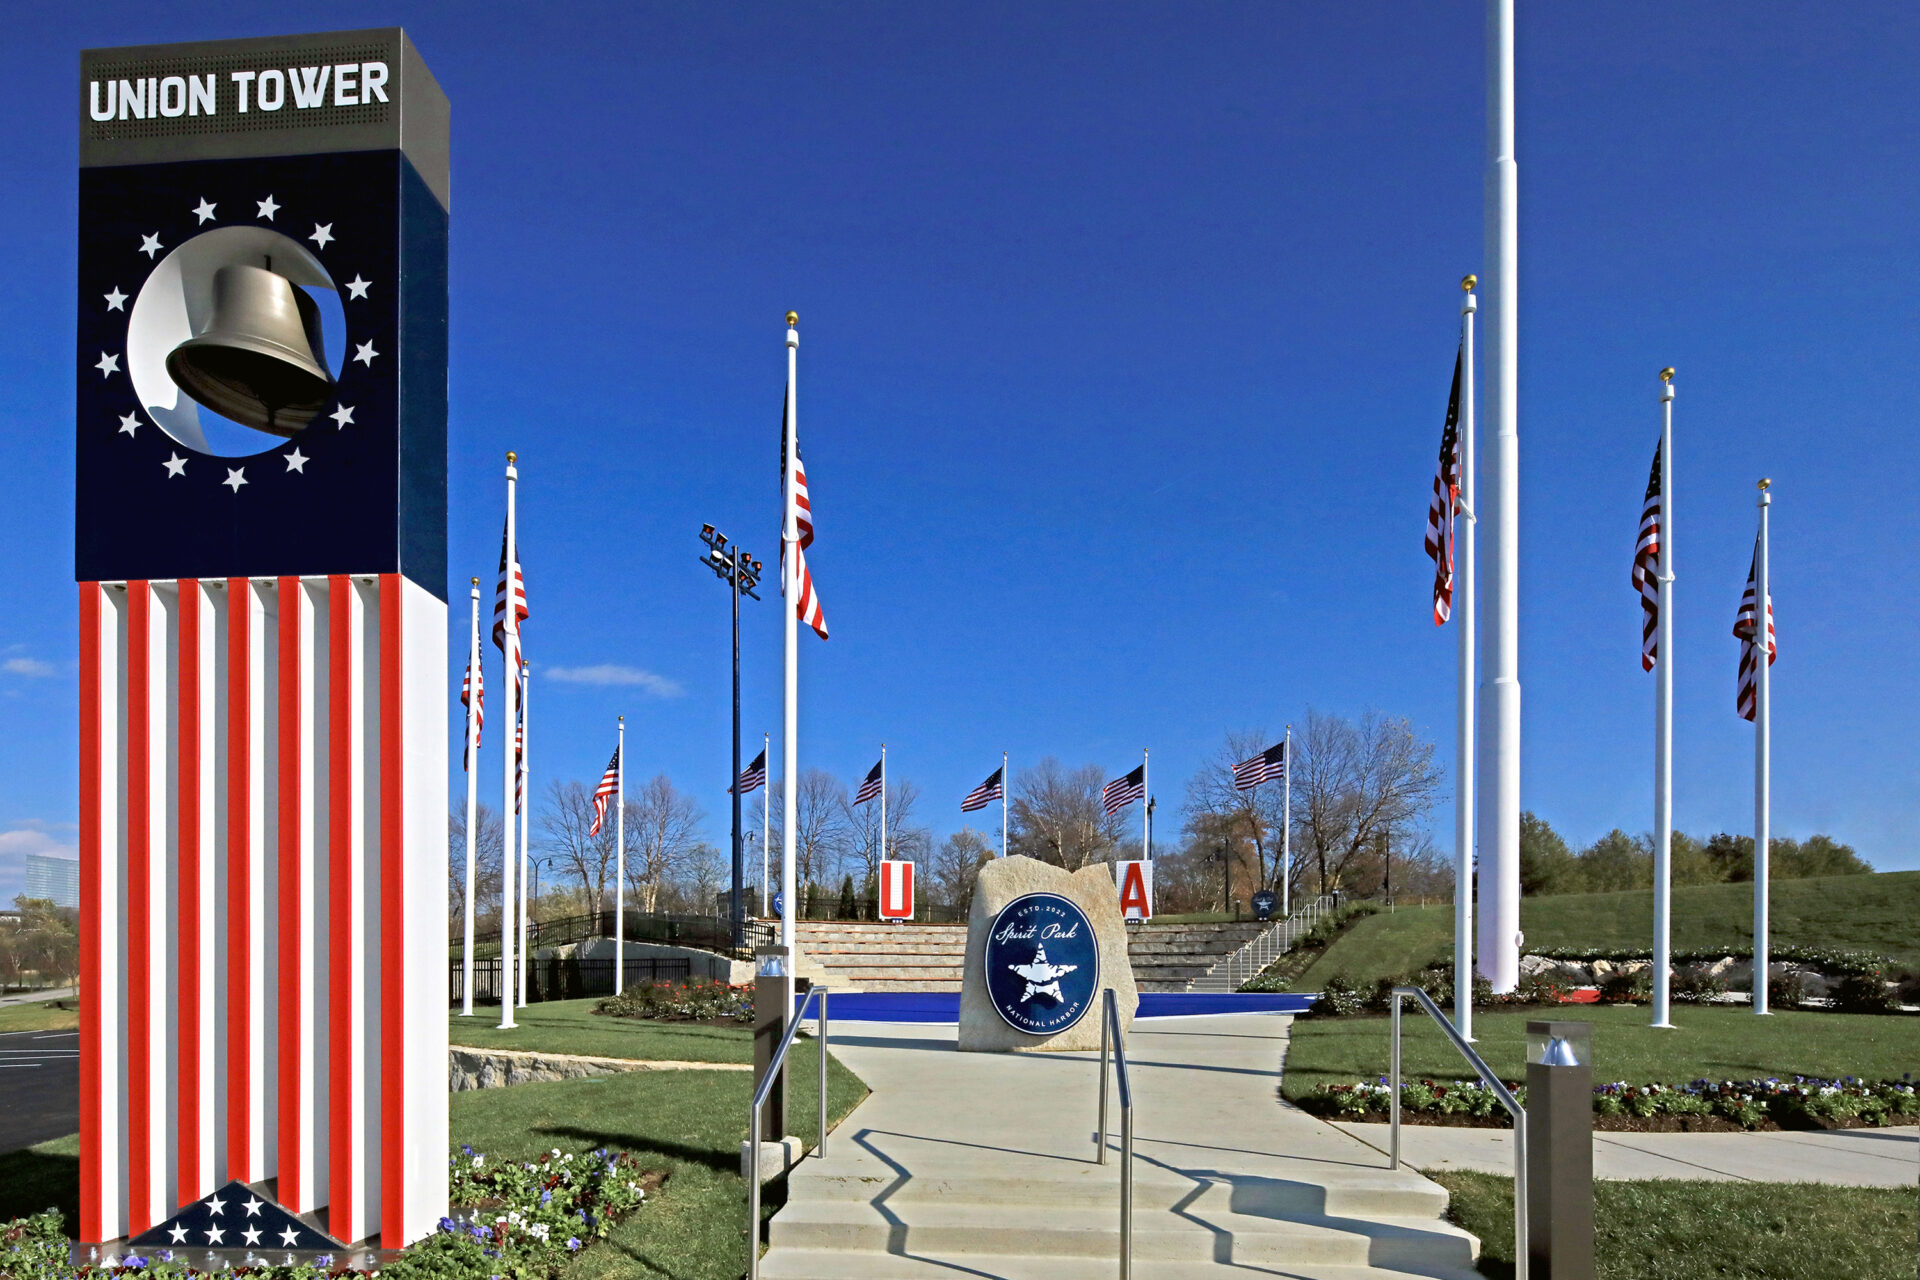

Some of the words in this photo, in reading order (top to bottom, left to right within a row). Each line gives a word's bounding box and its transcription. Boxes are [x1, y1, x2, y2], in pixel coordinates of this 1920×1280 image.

[90, 73, 216, 122] UNION
[231, 61, 389, 113] TOWER
[881, 862, 912, 918] U
[1120, 862, 1151, 918] A
[1045, 905, 1066, 918] 2022
[995, 922, 1038, 946] Spirit
[1040, 922, 1079, 940] Park
[1006, 1004, 1046, 1027] NATIONAL
[1049, 1001, 1080, 1026] HARBOR
